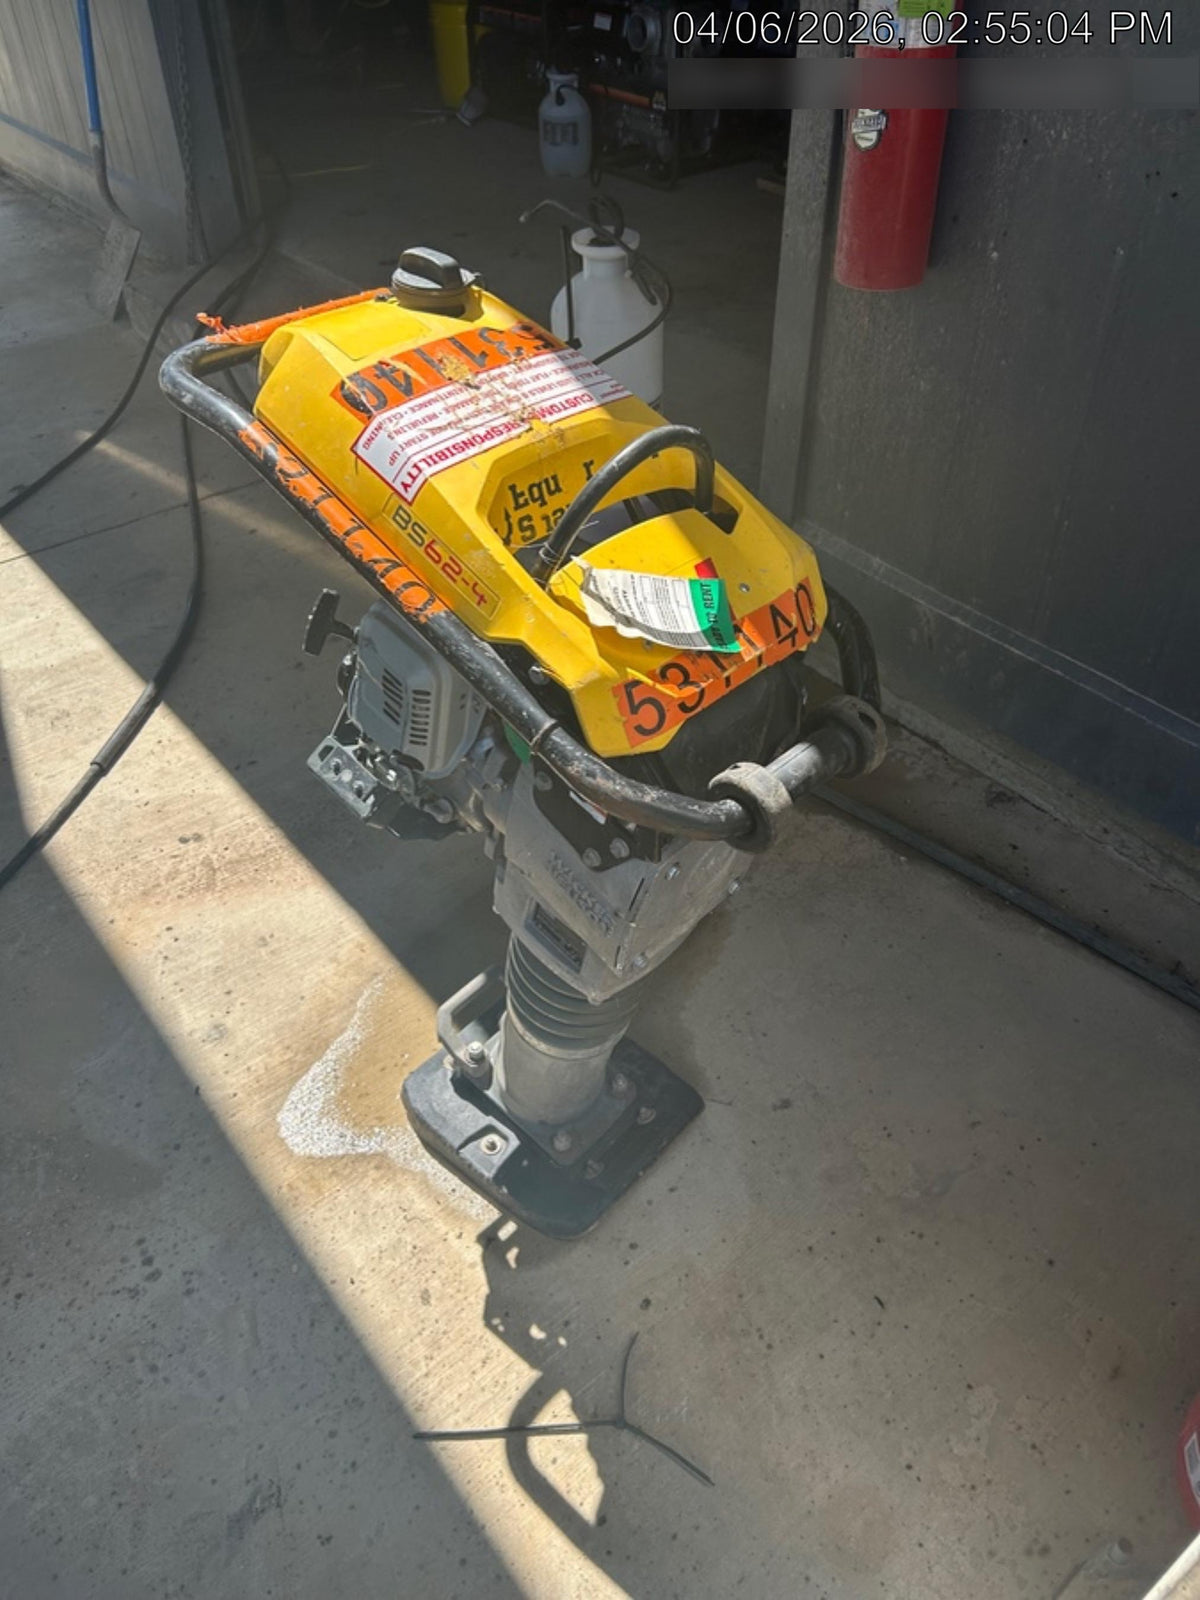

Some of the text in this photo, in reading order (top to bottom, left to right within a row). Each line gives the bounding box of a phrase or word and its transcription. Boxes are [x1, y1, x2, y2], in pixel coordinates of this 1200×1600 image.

[388, 450, 400, 466] UP
[392, 504, 486, 606] BS62-4
[699, 582, 714, 608] RENT
